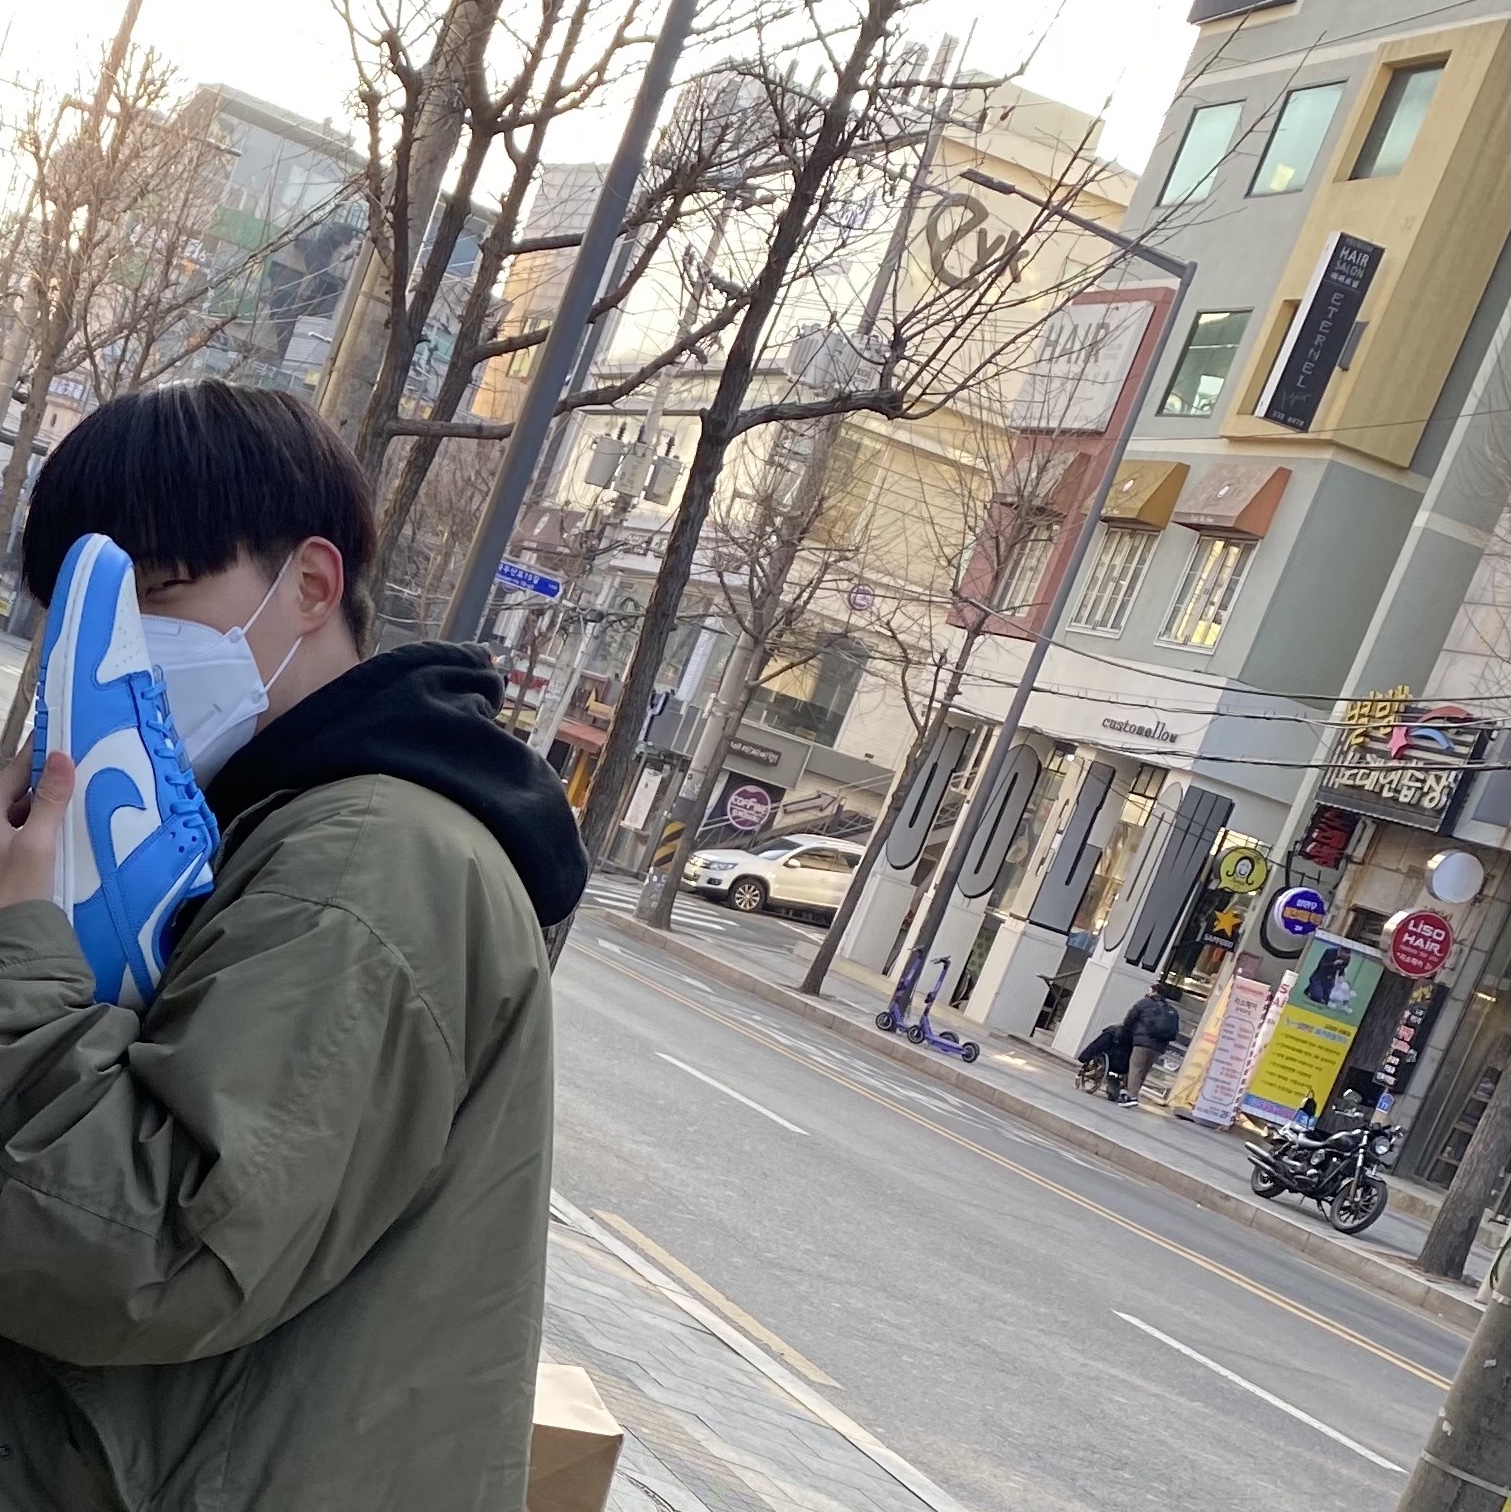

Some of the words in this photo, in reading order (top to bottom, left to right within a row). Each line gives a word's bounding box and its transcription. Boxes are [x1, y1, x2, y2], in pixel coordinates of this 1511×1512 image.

[1338, 246, 1370, 268] HAIR
[1334, 259, 1366, 279] SALON
[1101, 717, 1179, 744] customellow
